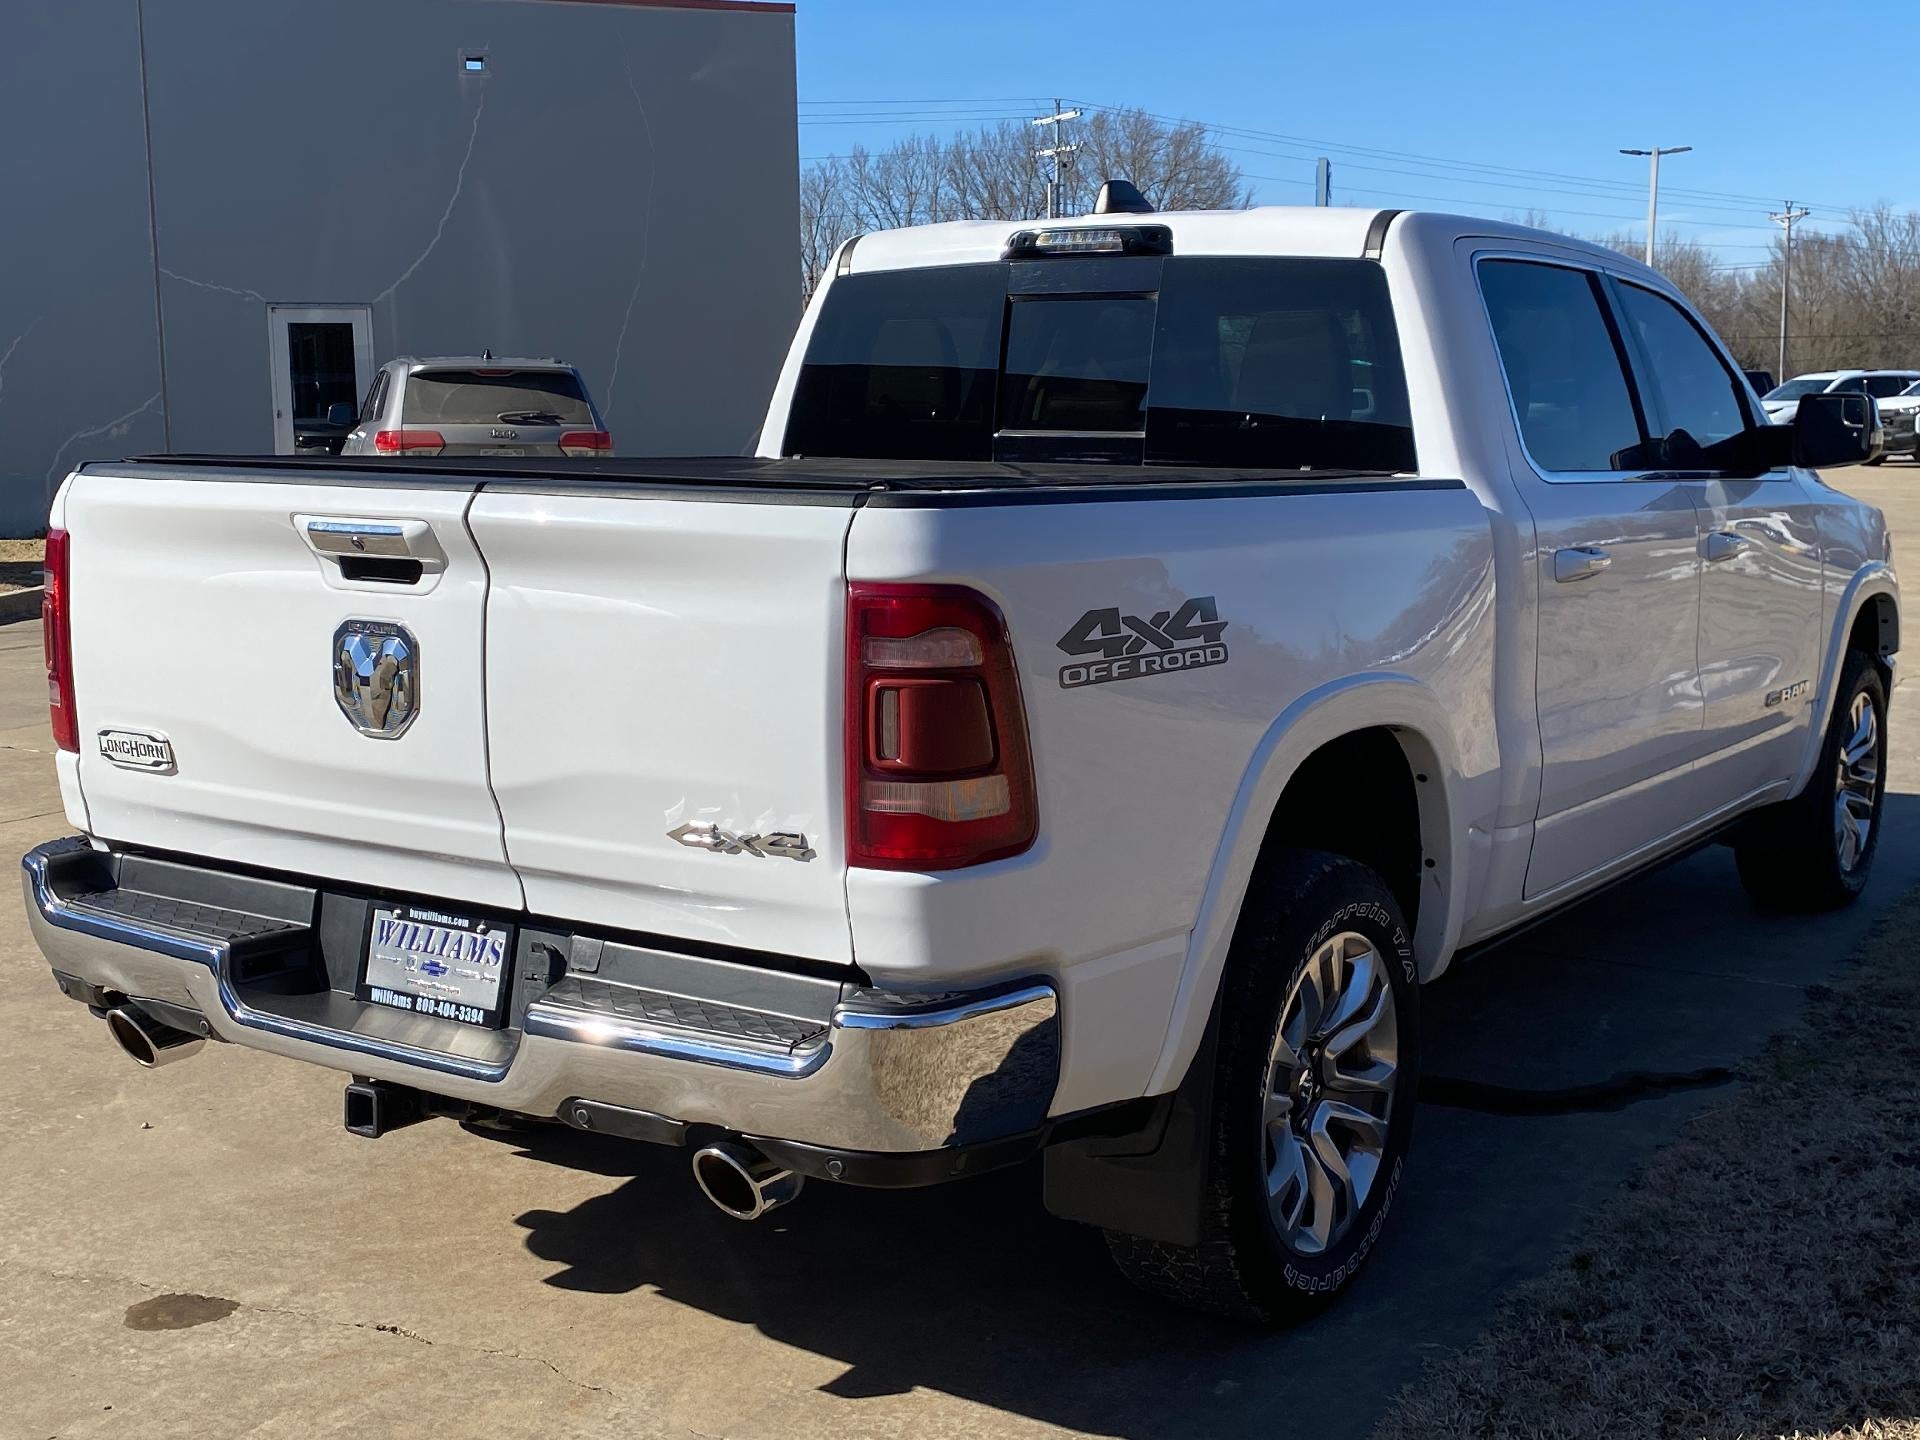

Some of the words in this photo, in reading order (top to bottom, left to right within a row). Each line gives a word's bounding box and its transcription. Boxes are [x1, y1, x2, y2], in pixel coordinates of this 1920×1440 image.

[1062, 660, 1131, 685] OFF
[1139, 647, 1226, 673] ROAD
[1781, 680, 1810, 701] RAM
[409, 908, 469, 928] buywilliams.com
[377, 919, 505, 967] WILLIAMS
[371, 988, 412, 1010] Williams
[415, 997, 484, 1025] 800-404-3394
